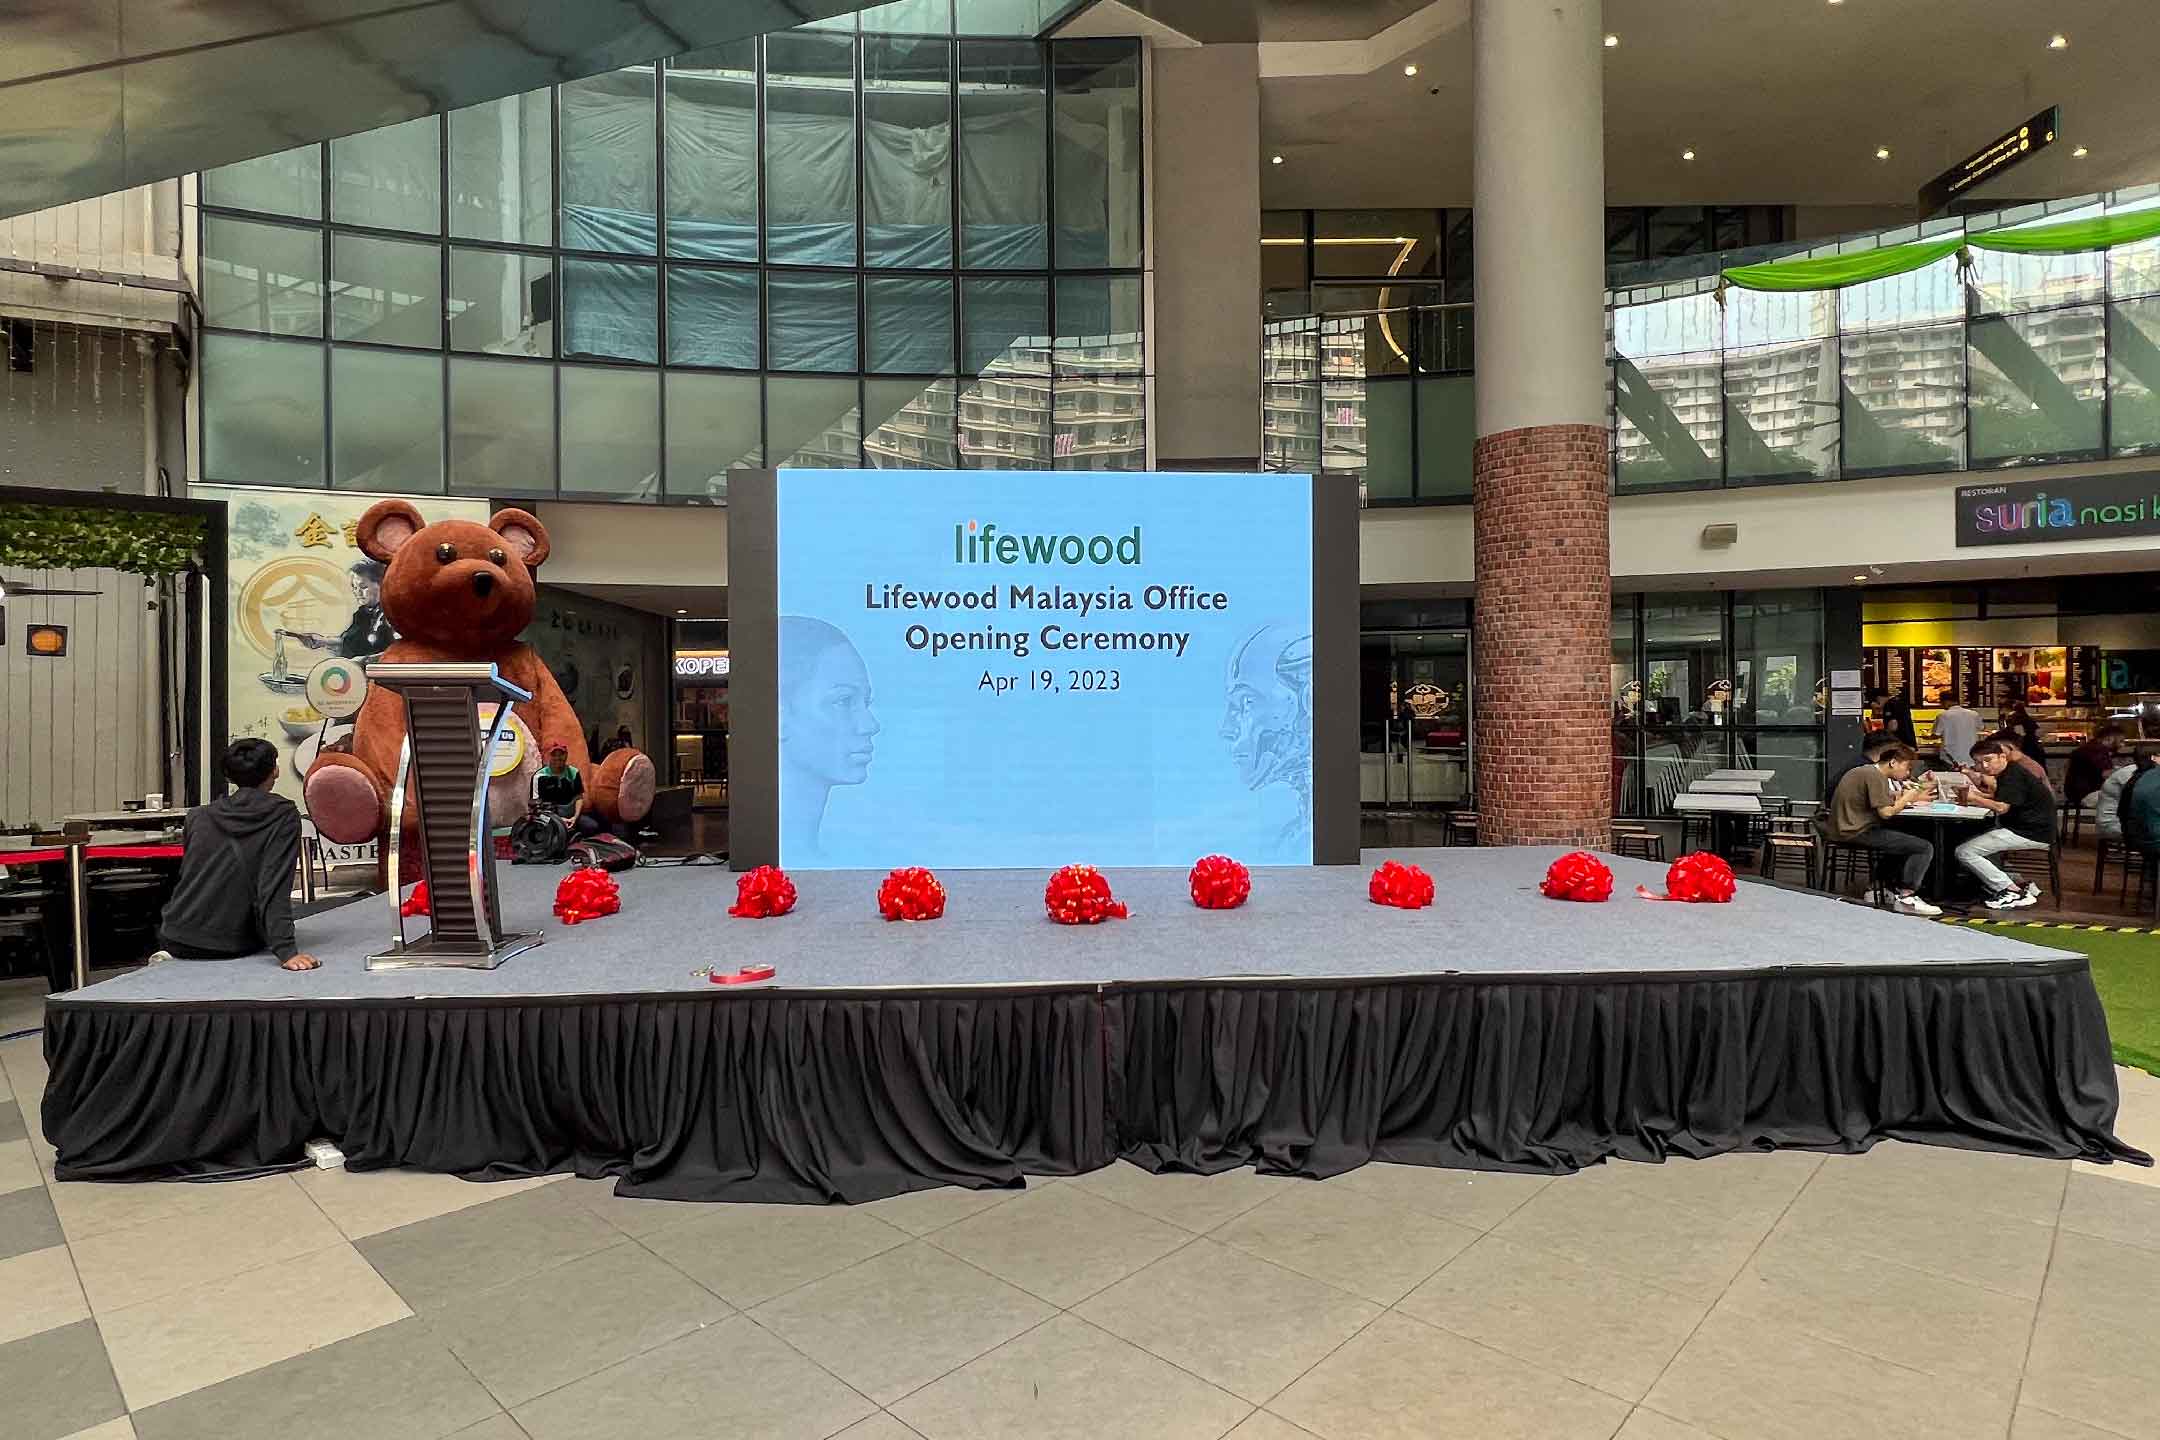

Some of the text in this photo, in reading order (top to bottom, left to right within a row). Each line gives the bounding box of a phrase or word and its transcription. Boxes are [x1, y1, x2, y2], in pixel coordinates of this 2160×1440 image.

[1961, 486, 2007, 497] RESTORAN
[1975, 493, 2077, 533] suria
[2080, 498, 2145, 525] nasi
[955, 520, 1141, 565] lifewood
[867, 584, 1228, 618] Lifewood Malaysia Office
[905, 625, 1190, 657] Opening Ceremony
[979, 670, 1120, 697] Apr 19, 2023
